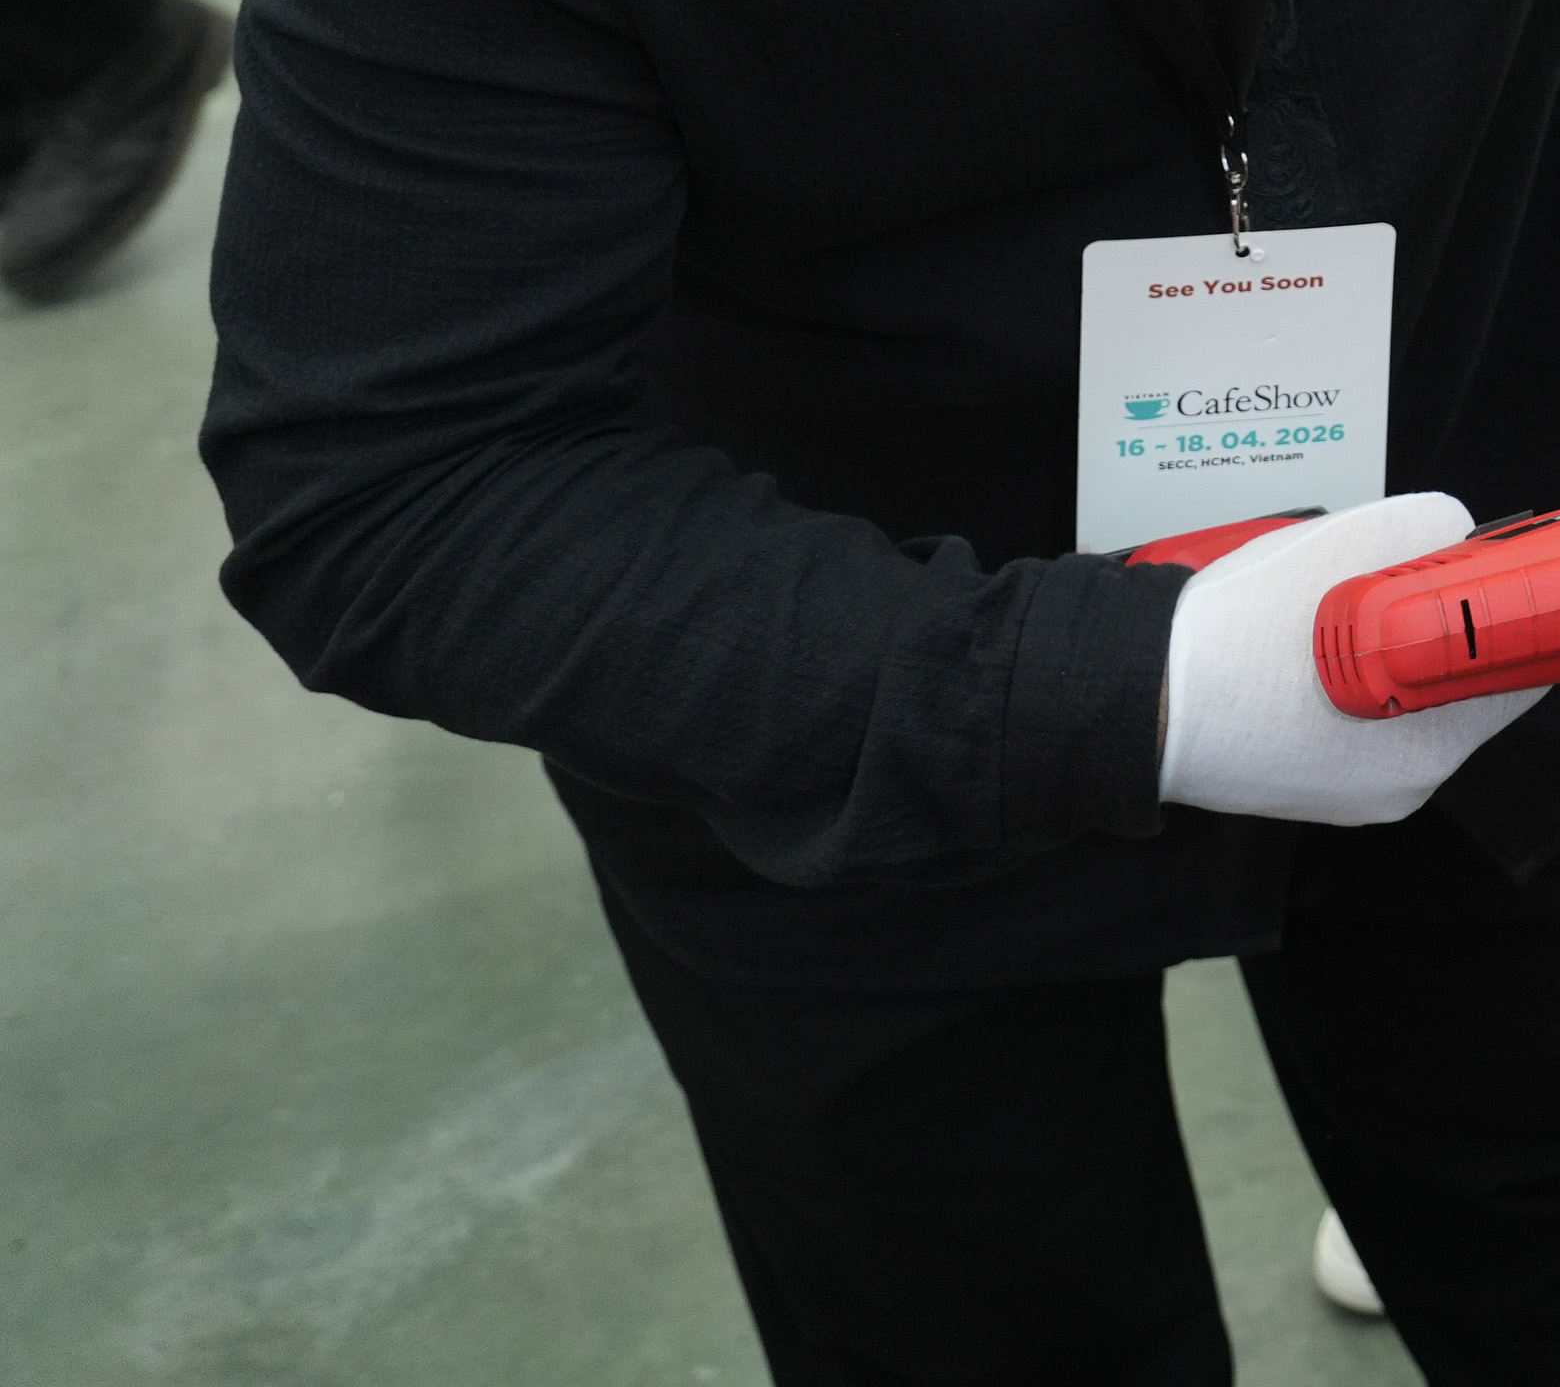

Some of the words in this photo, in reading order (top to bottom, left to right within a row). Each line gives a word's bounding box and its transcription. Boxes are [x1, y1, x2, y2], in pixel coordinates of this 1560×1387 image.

[1148, 284, 1194, 299] See
[1203, 280, 1252, 295] You
[1260, 275, 1325, 291] Soon
[1177, 384, 1341, 417] CafeShow
[1116, 439, 1145, 457] 16
[1176, 435, 1212, 453] 18.
[1222, 430, 1266, 449] 04.
[1275, 424, 1345, 446] 2026
[1158, 459, 1197, 472] SECC,
[1201, 455, 1245, 468] HCMC,
[1250, 451, 1304, 463] Vietnam
